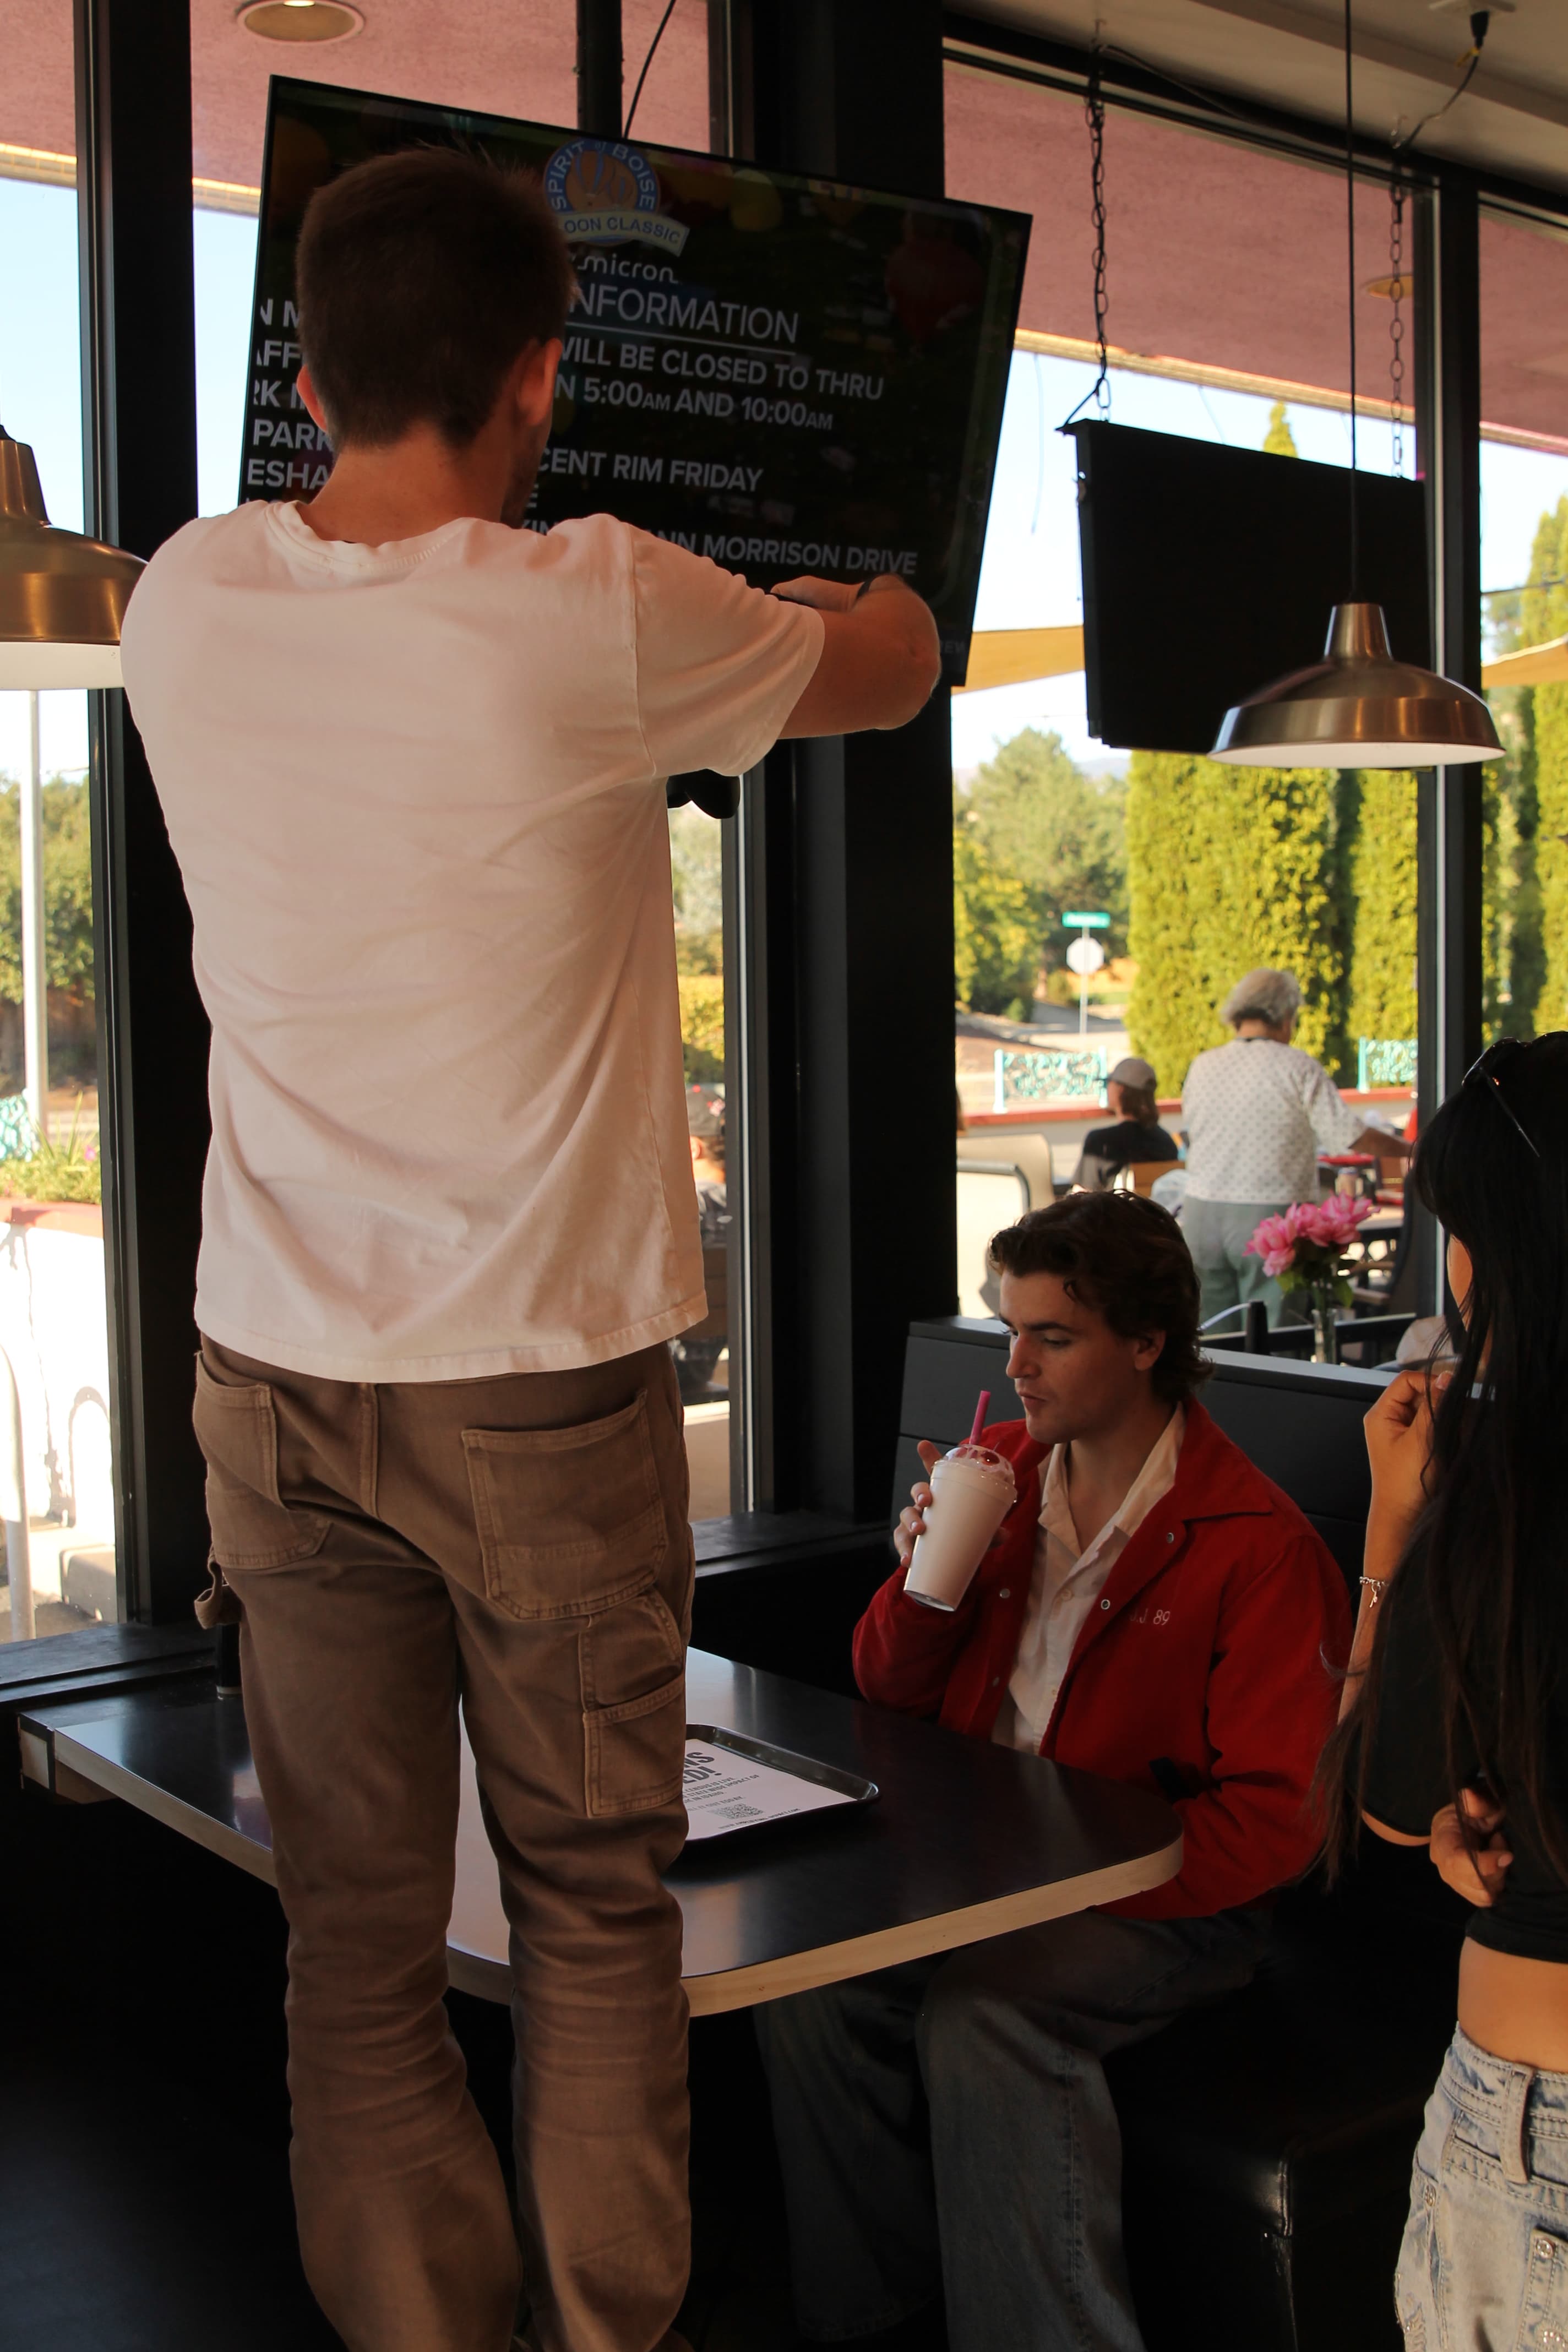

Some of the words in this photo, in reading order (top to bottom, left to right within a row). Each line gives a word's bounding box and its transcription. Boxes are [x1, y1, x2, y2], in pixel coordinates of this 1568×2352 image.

[548, 140, 586, 210] SPIRIT
[612, 143, 656, 210] BOISE
[564, 217, 602, 233] OON
[607, 217, 681, 243] CLASSIC
[578, 253, 680, 285] micron
[569, 282, 799, 344] NFORMATION
[618, 342, 655, 372] BE
[661, 349, 767, 385] CLOSED
[775, 362, 809, 391] TO
[815, 368, 885, 401] THRU
[674, 388, 734, 419] AND
[612, 454, 663, 483] RIM
[668, 459, 765, 493] FRIDAY
[701, 533, 841, 568] MORRISON
[845, 546, 919, 575] DRIVE
[1153, 1609, 1171, 1625] 89
